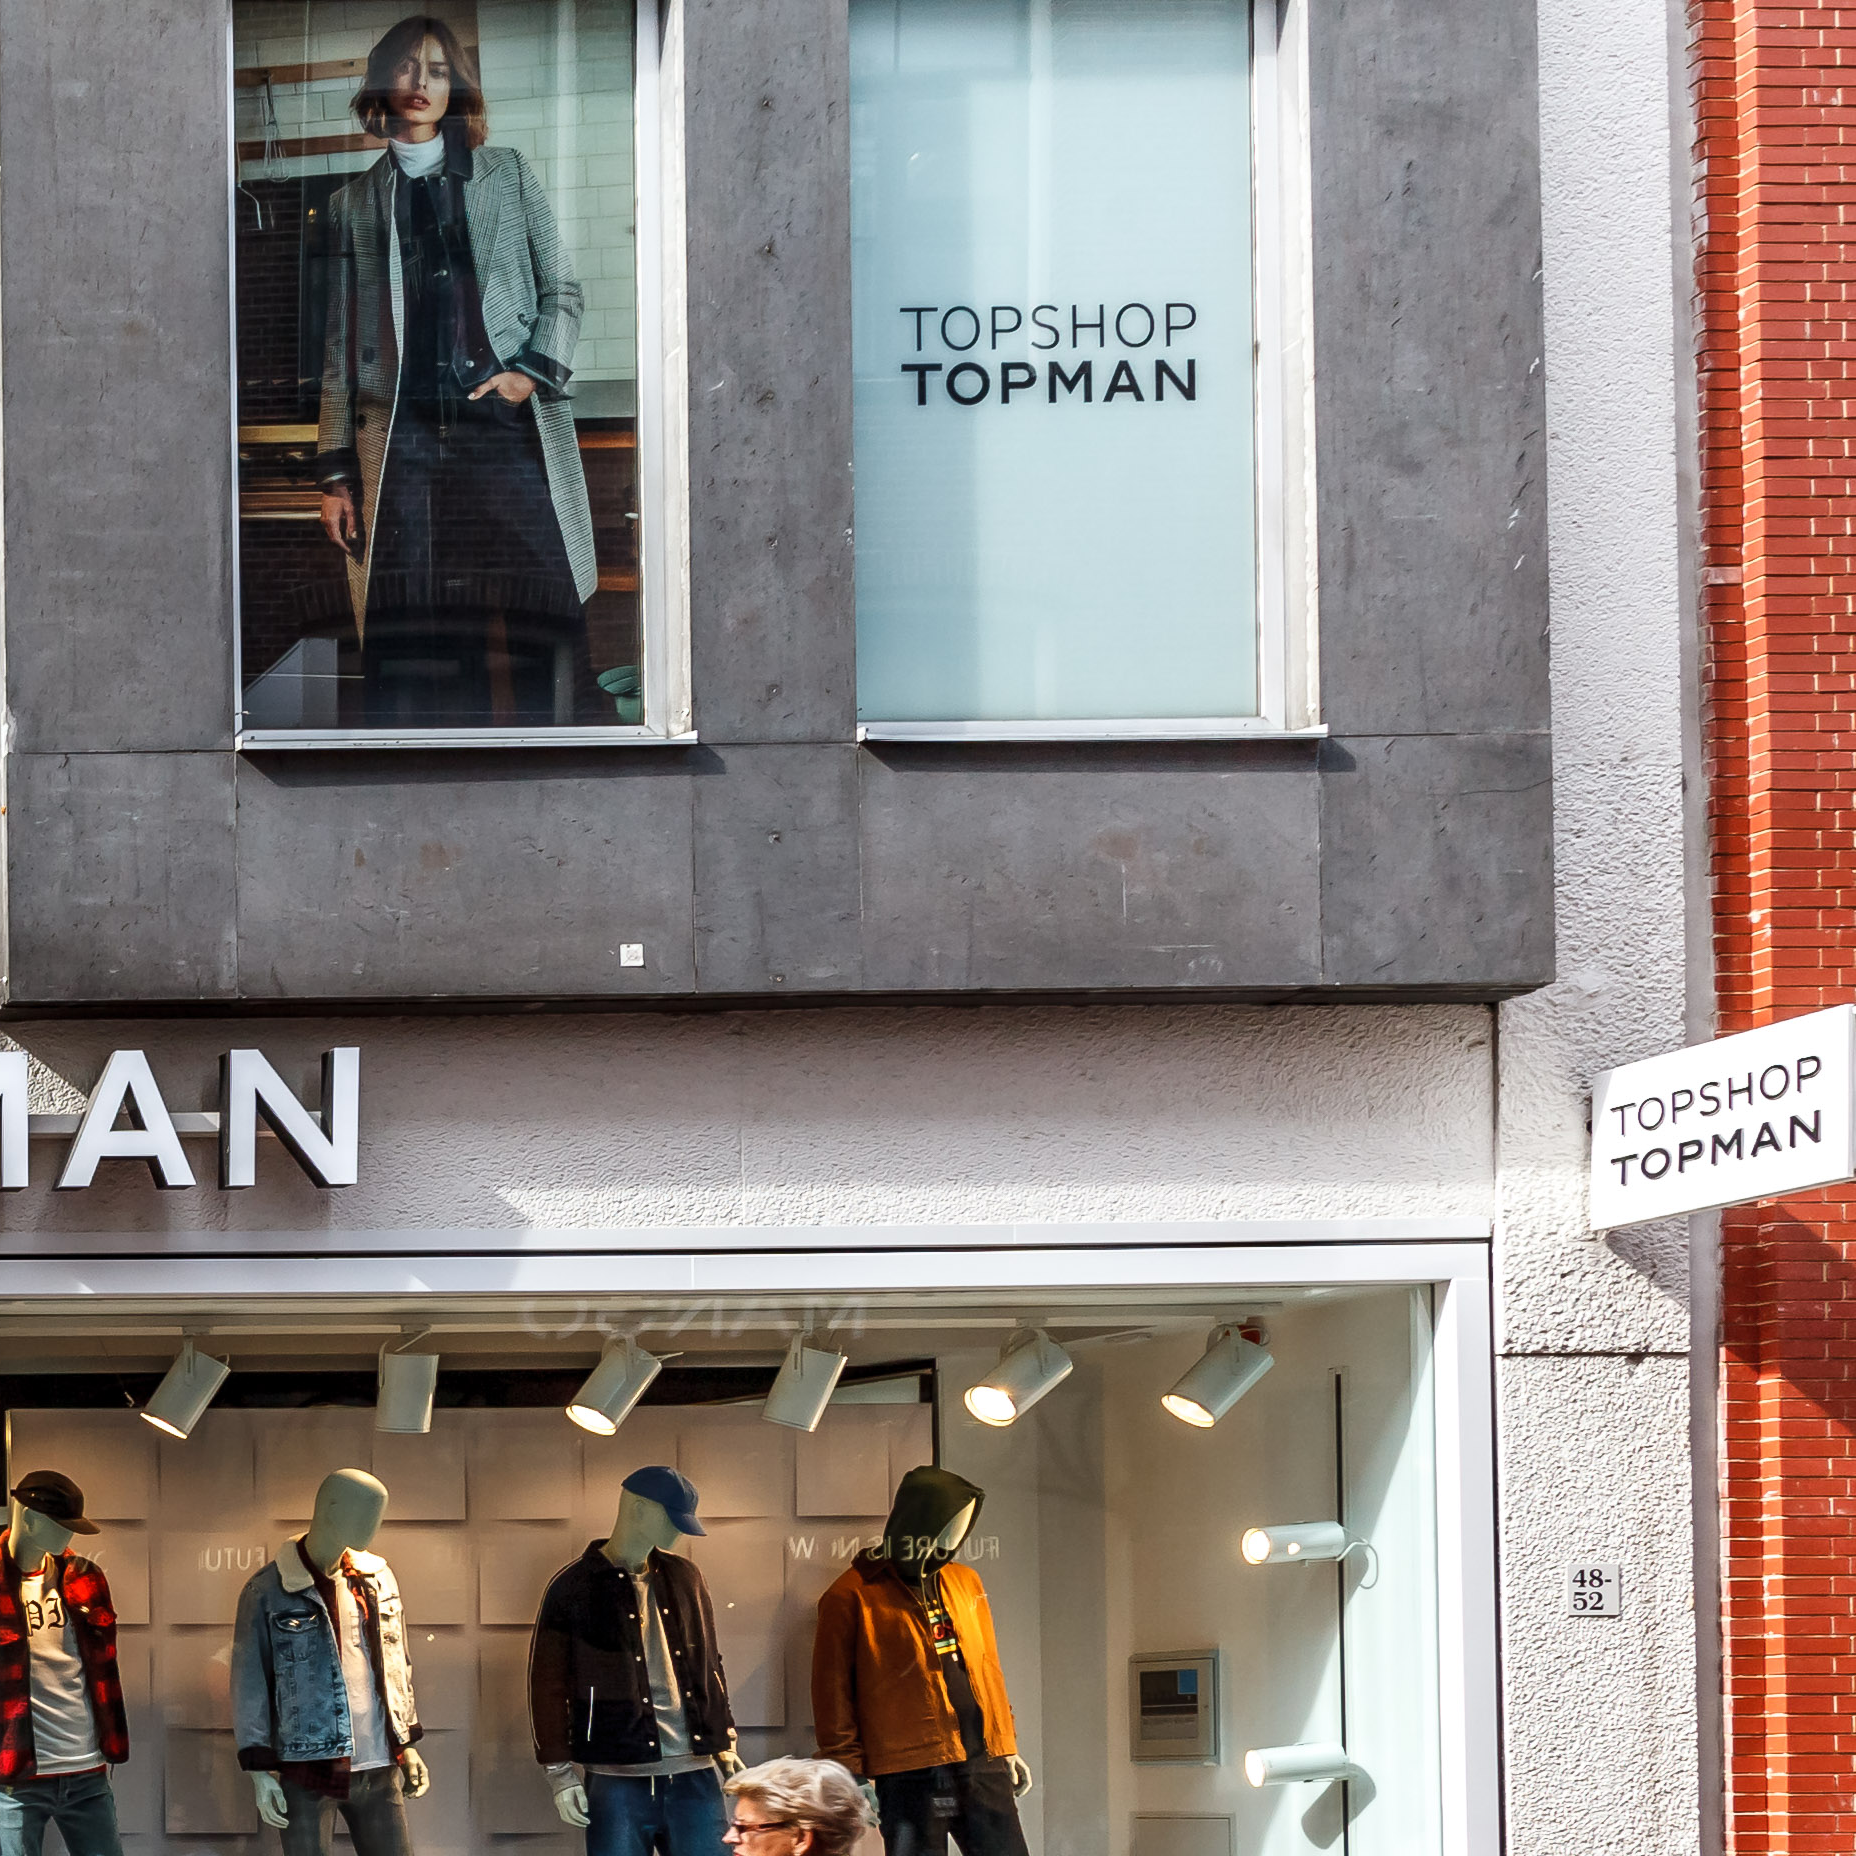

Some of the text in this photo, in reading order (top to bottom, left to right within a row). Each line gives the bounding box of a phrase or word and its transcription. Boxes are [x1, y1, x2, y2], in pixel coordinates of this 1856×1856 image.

[899, 302, 1197, 352] TOPSHOP
[900, 358, 1197, 406] TOPMAN
[1609, 1055, 1822, 1137] TOPSHOP
[1610, 1109, 1822, 1187] TOPMAN
[1572, 1568, 1612, 1588] 48-
[1573, 1591, 1604, 1611] 52
